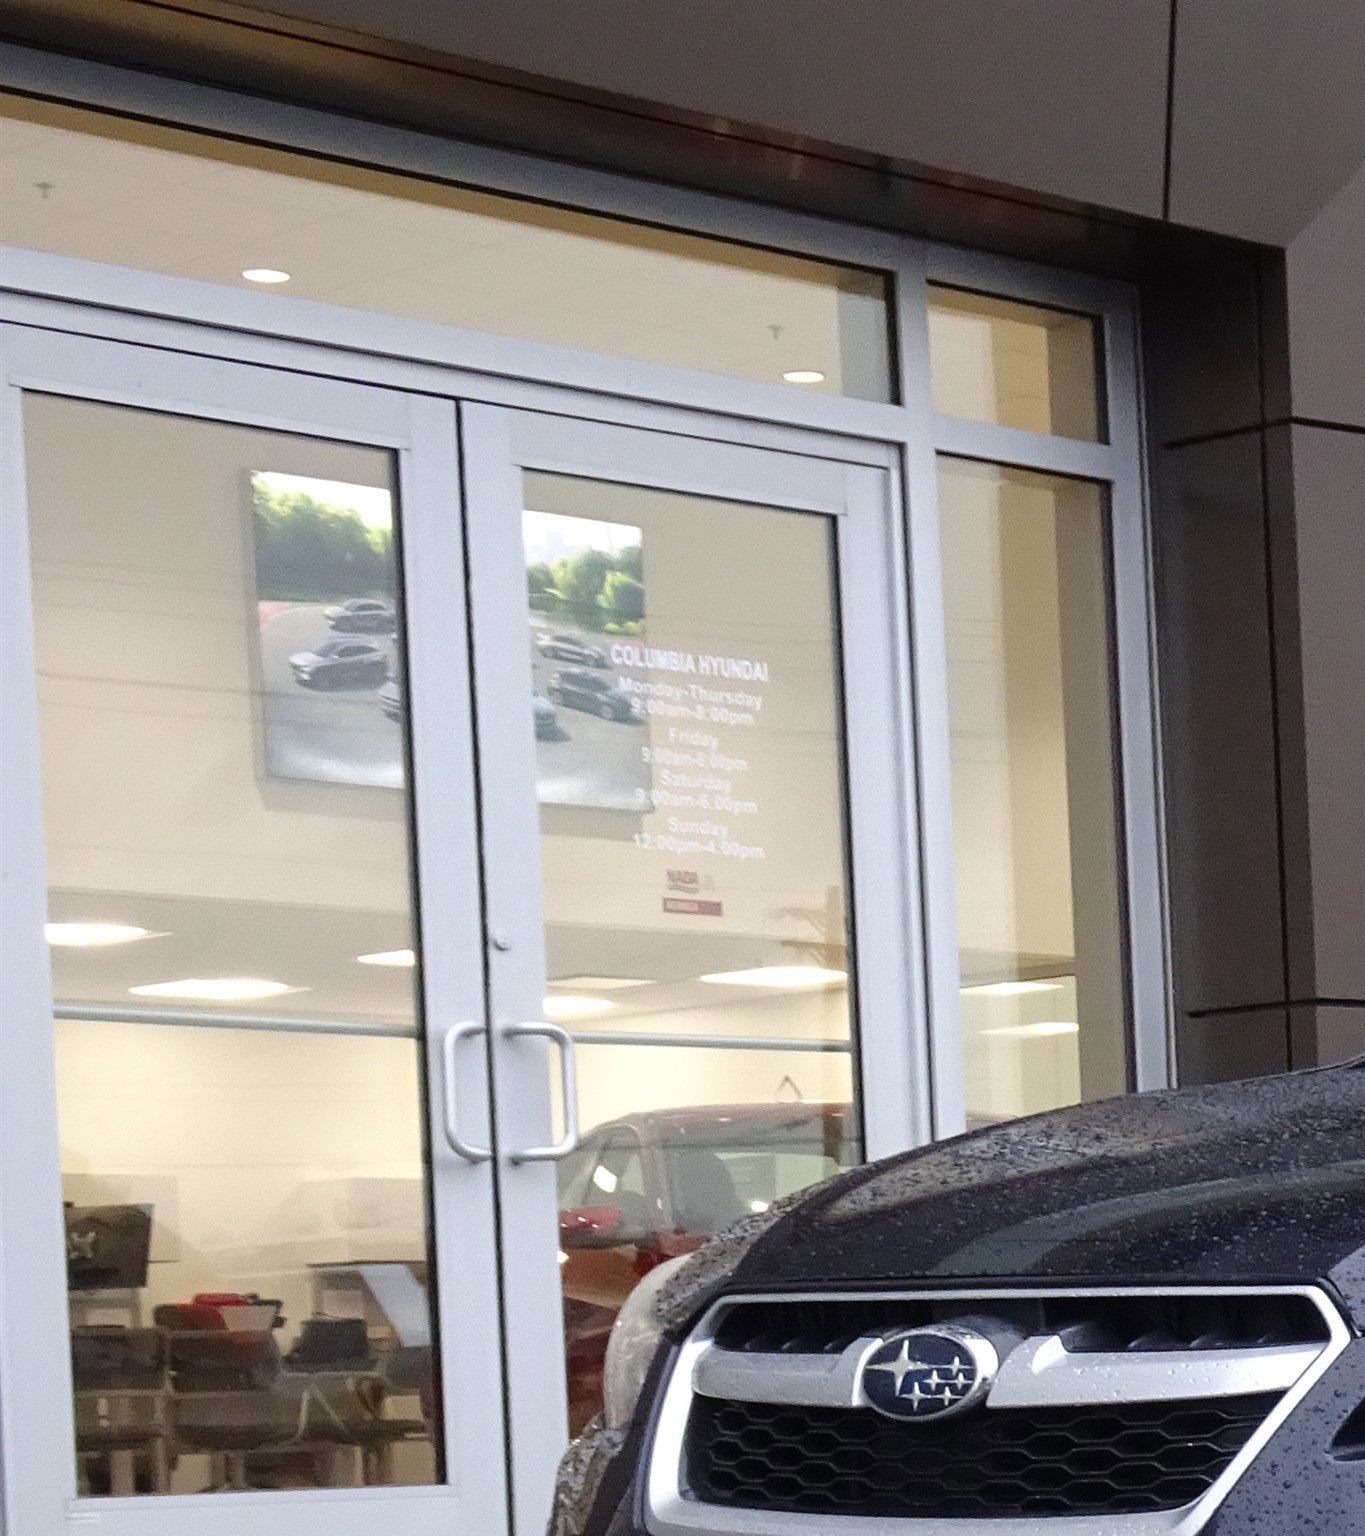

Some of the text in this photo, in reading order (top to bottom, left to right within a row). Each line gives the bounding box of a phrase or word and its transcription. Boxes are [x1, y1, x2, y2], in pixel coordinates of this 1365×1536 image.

[610, 643, 769, 682] COLUMBIA HYUNDAI
[668, 727, 719, 752] Friday
[660, 768, 731, 796] Saturday
[667, 815, 729, 842] Sunday
